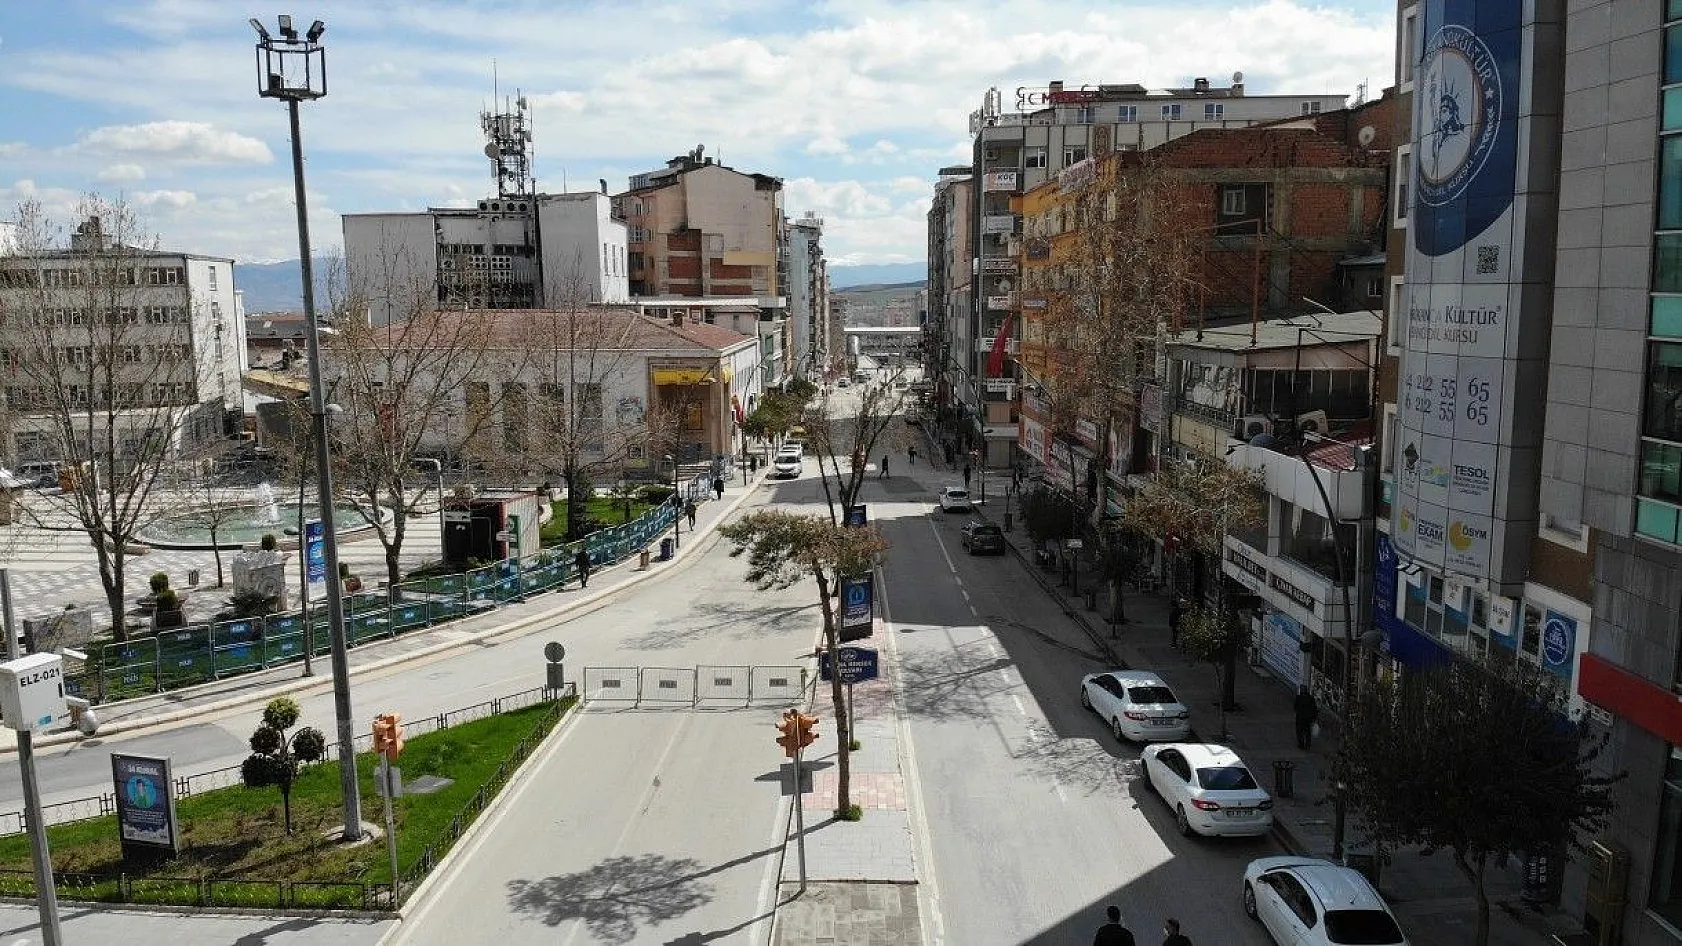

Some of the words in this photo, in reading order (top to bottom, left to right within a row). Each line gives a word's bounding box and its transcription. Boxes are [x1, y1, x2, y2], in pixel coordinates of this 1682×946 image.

[1468, 377, 1490, 402] 65
[1466, 400, 1488, 426] 65
[1454, 465, 1490, 481] TESOL
[1418, 524, 1444, 541] EXAM
[20, 668, 60, 688] ELZ-021
